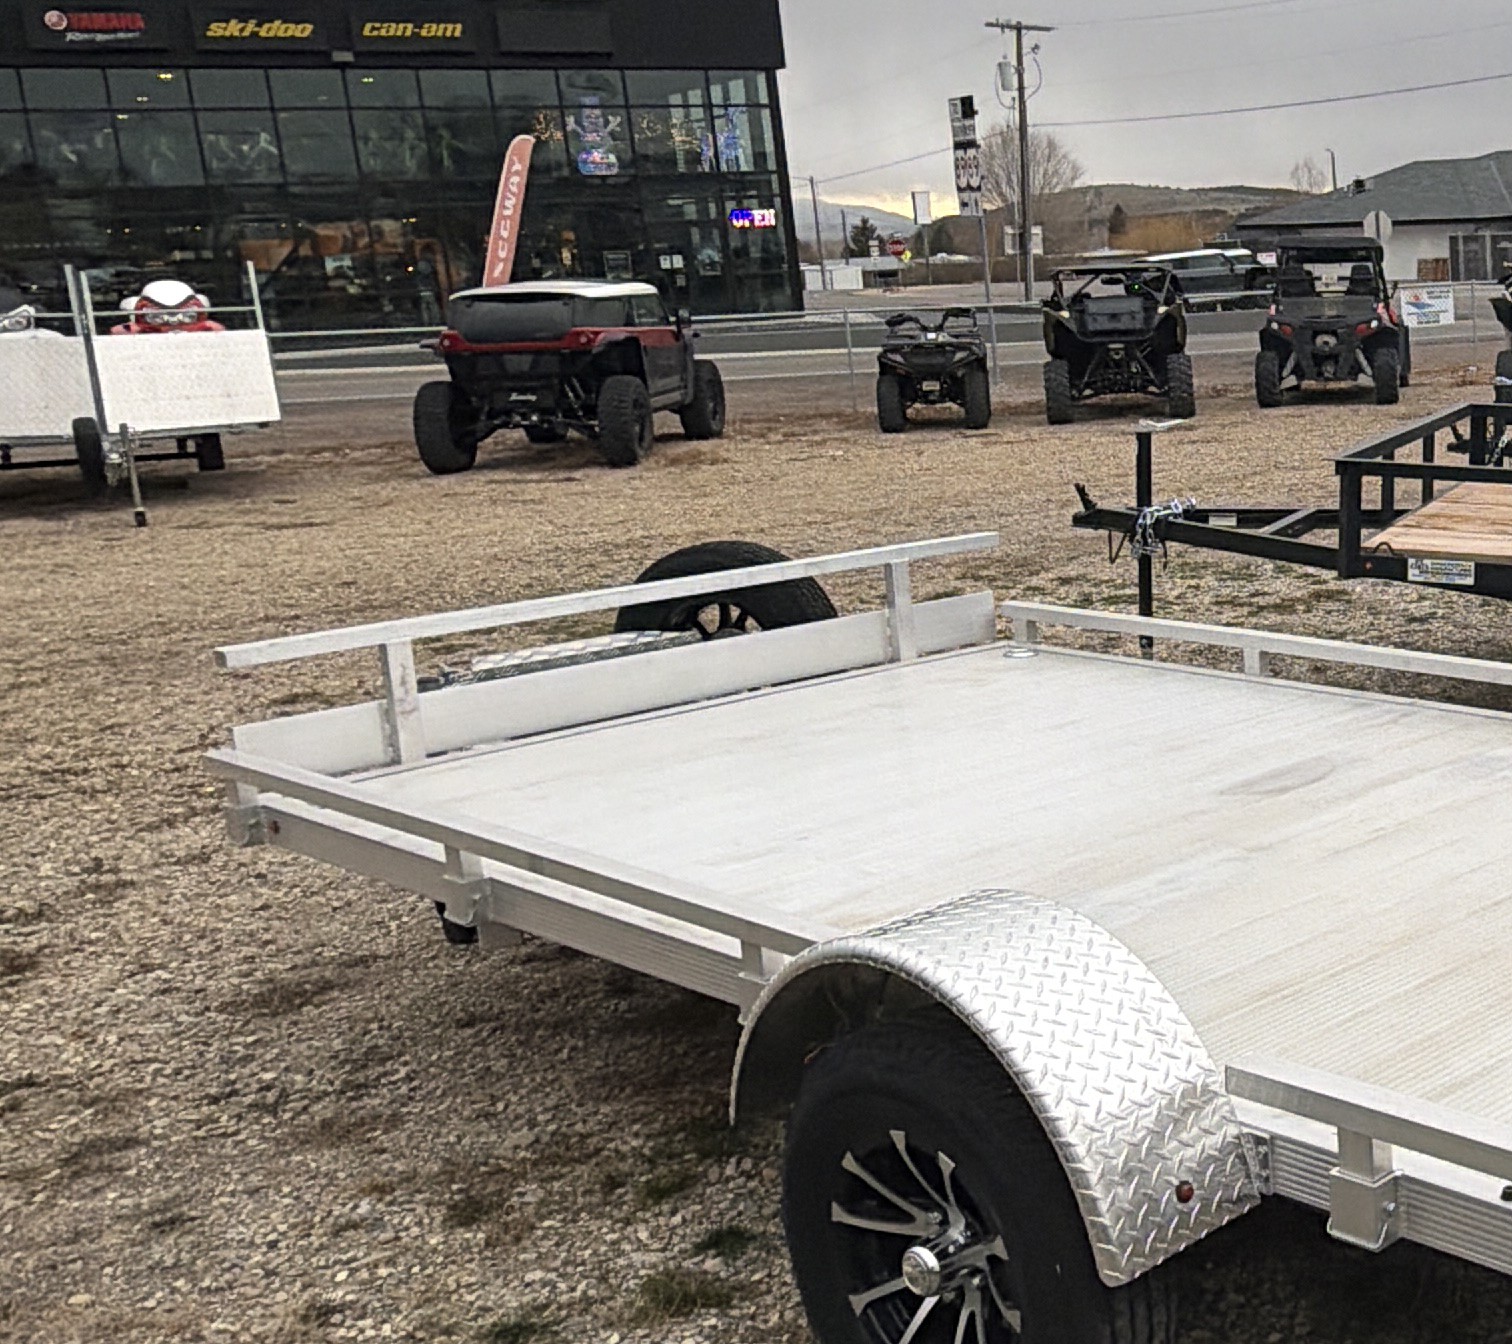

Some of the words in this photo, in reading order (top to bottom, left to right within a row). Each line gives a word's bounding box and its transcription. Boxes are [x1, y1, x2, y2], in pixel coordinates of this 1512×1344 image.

[206, 19, 314, 38] ski-doo
[362, 21, 463, 38] can-am
[730, 209, 776, 227] OPEN
